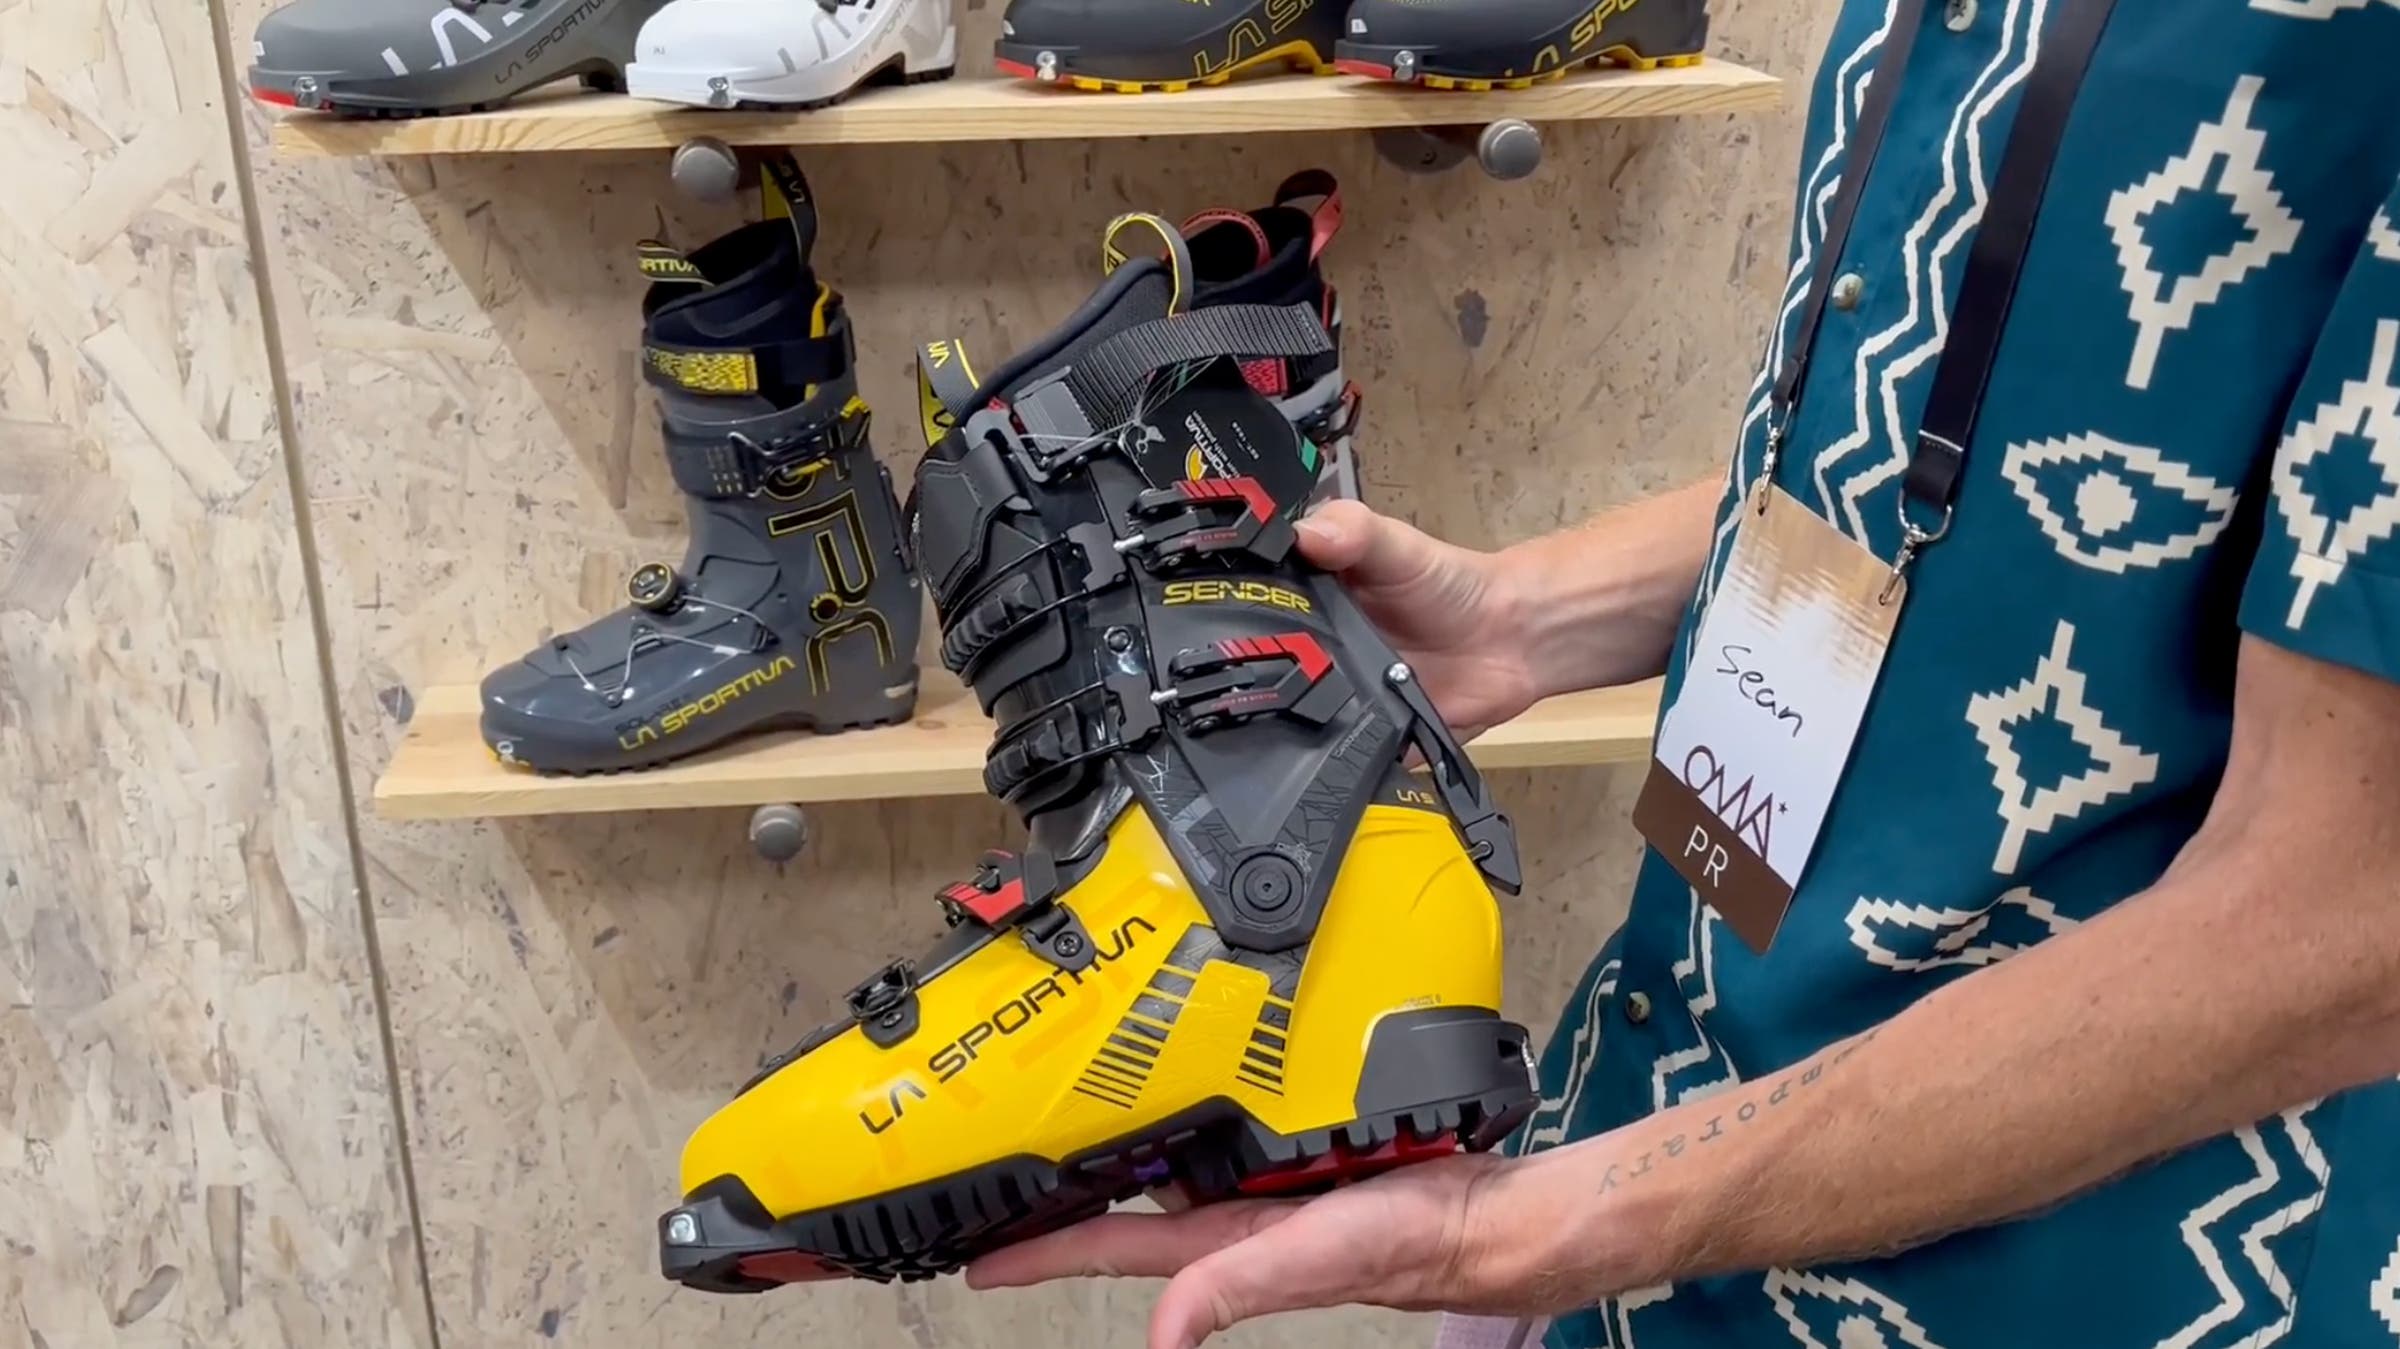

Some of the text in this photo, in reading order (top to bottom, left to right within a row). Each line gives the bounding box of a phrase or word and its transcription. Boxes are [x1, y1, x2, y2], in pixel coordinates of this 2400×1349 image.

[637, 256, 703, 277] RTIVA
[1185, 415, 1231, 479] PORTIVA
[1161, 579, 1312, 615] SENDER
[618, 723, 659, 750] LA
[660, 655, 796, 735] SPORTIVA
[1716, 644, 1804, 738] Sean
[1684, 824, 1729, 888] PR
[858, 915, 1158, 1135] LA SPORTVA
